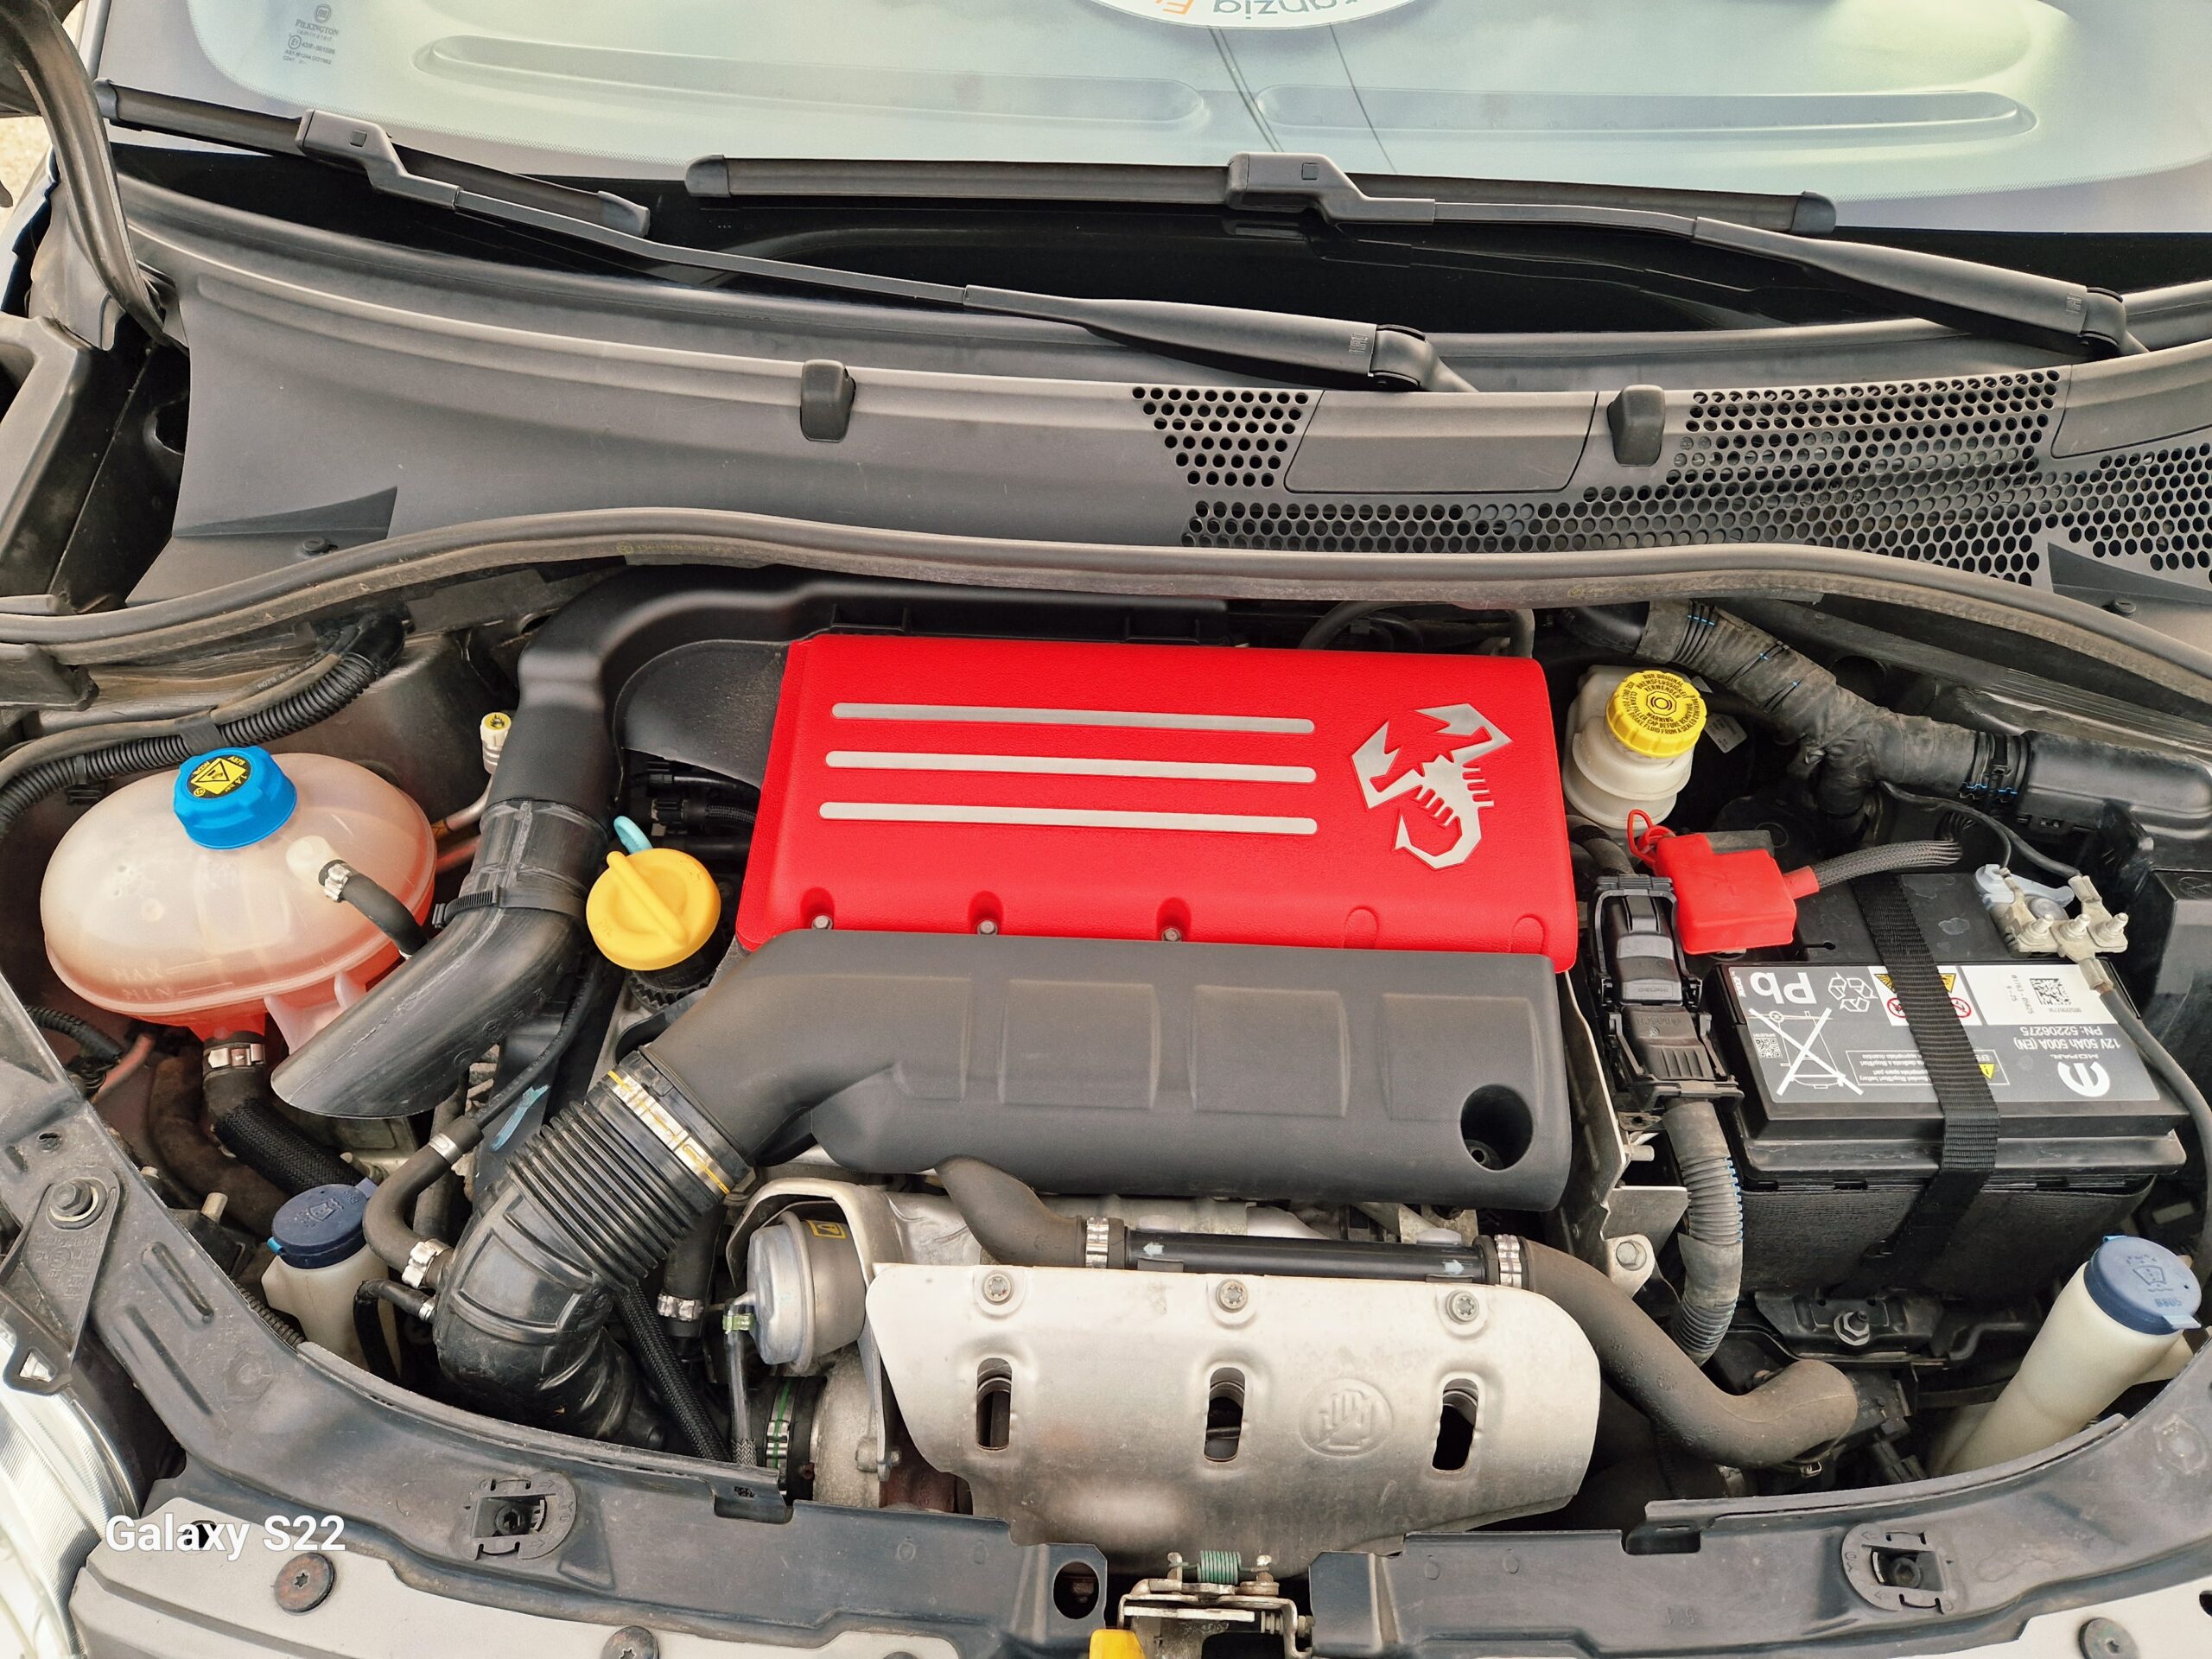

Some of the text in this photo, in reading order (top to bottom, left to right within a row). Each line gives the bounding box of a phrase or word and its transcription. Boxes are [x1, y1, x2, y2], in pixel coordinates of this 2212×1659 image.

[1156, 0, 1194, 15] E
[295, 19, 339, 35] PILKINGTON
[1626, 681, 1636, 690] USE
[1656, 673, 1684, 687] ORIGINAL
[1630, 691, 1638, 707] CLEAN
[1633, 705, 1648, 721] FILLER
[1681, 702, 1693, 725] REMOVING
[1689, 695, 1701, 721] CONTAINER
[1628, 711, 1644, 727] BRAKE
[1646, 712, 1674, 722] WARNING
[1647, 717, 1659, 727] CAP
[1643, 723, 1661, 734] FLUID
[1681, 719, 1698, 733] SEALED
[1750, 971, 1817, 1004] Pb
[2019, 1026, 2103, 1037] PN: 52206275
[2013, 1036, 2121, 1051] 12V 50Ah 500A (EN)
